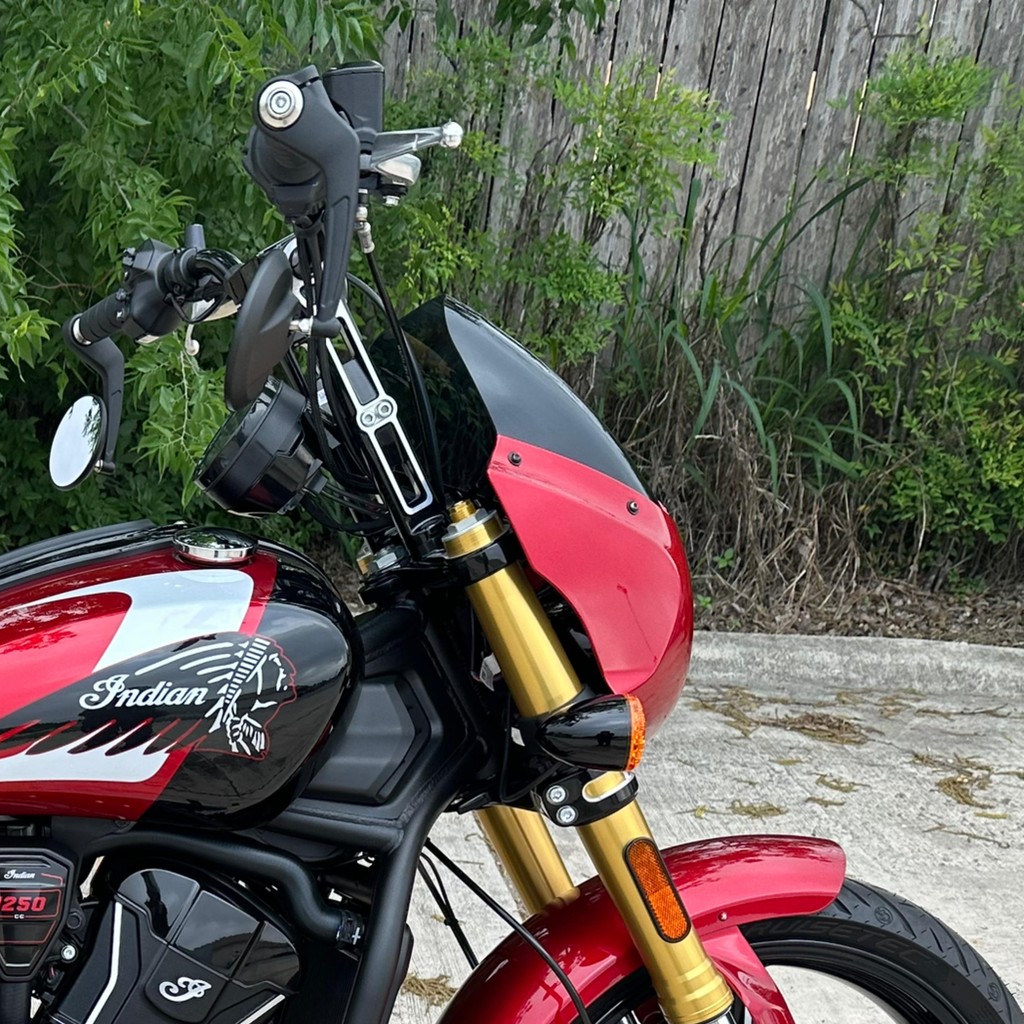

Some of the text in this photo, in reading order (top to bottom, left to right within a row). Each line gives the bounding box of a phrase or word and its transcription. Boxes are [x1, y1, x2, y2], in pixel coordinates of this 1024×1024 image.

[79, 674, 208, 710] Indian
[4, 870, 36, 879] Indian
[744, 919, 933, 966] RUISETEC
